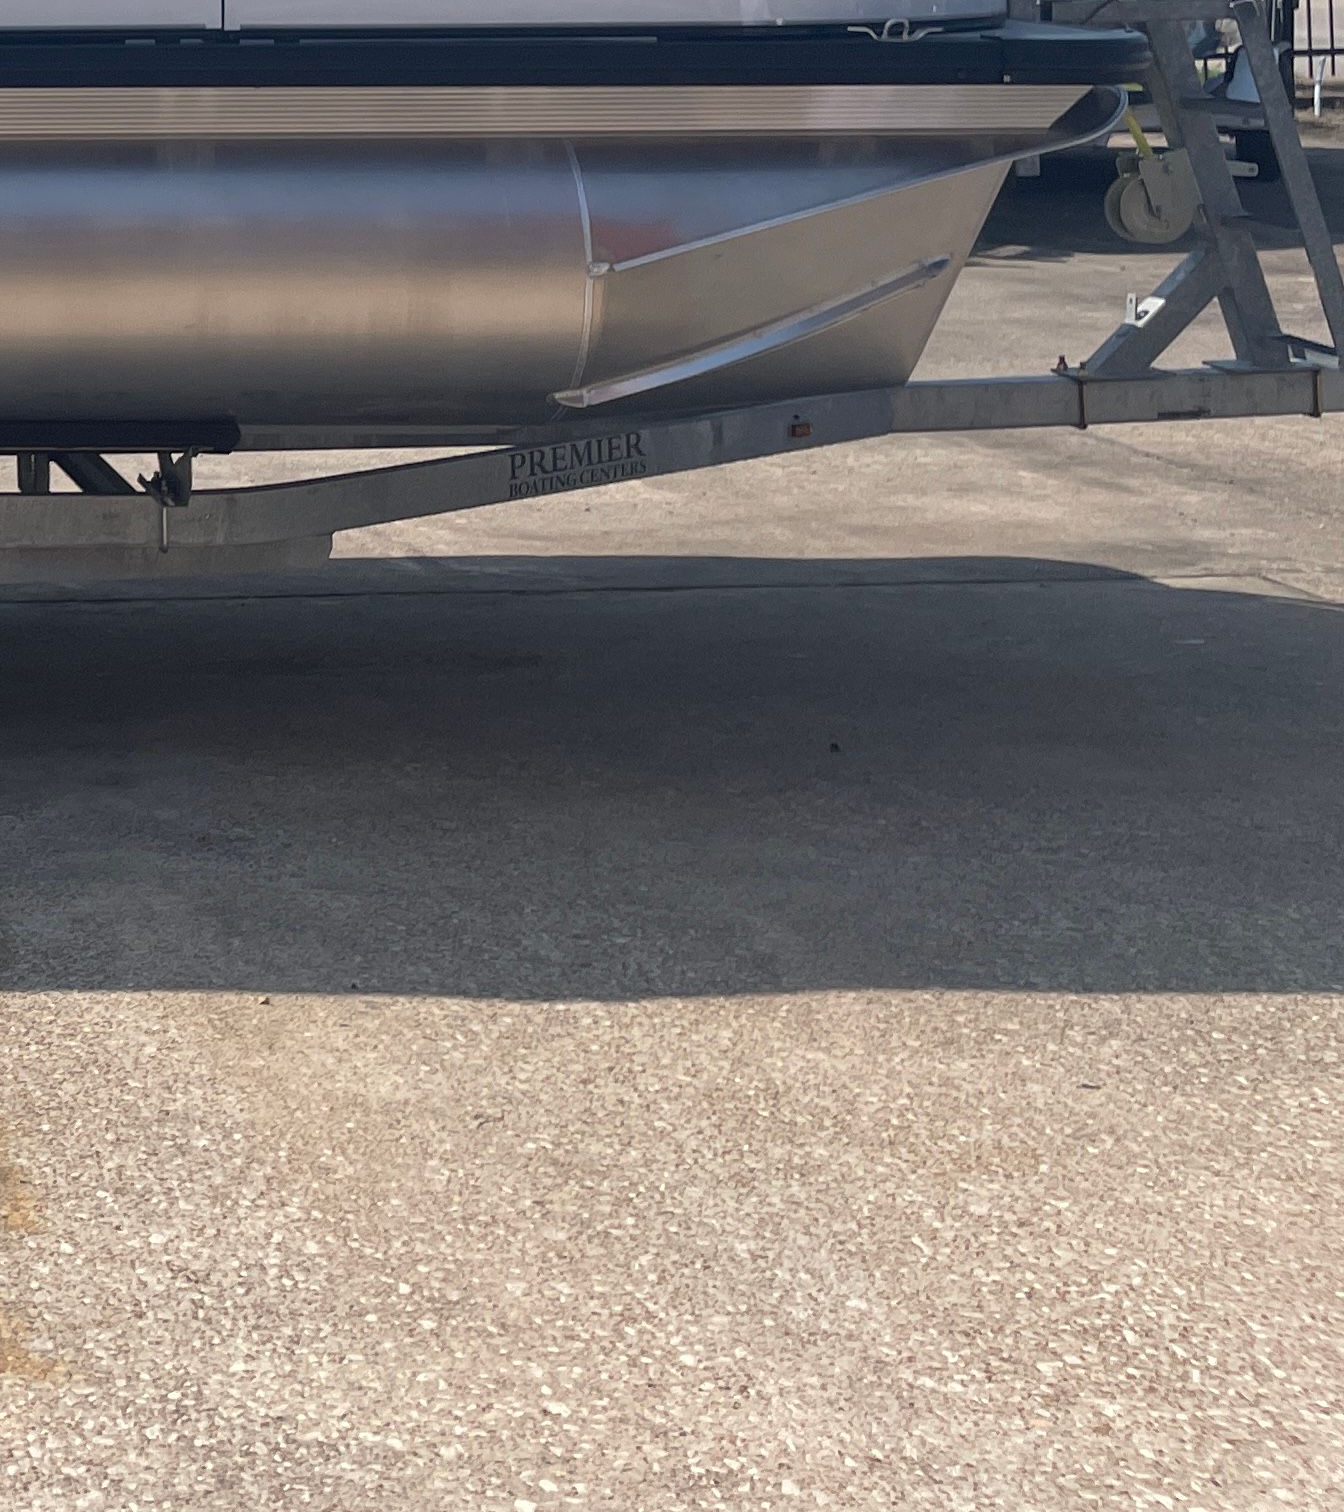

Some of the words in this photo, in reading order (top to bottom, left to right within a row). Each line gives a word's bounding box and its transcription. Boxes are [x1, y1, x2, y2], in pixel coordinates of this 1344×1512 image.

[508, 432, 647, 480] PREMIER
[509, 472, 577, 498] BOATING
[579, 460, 648, 485] CENTERS
